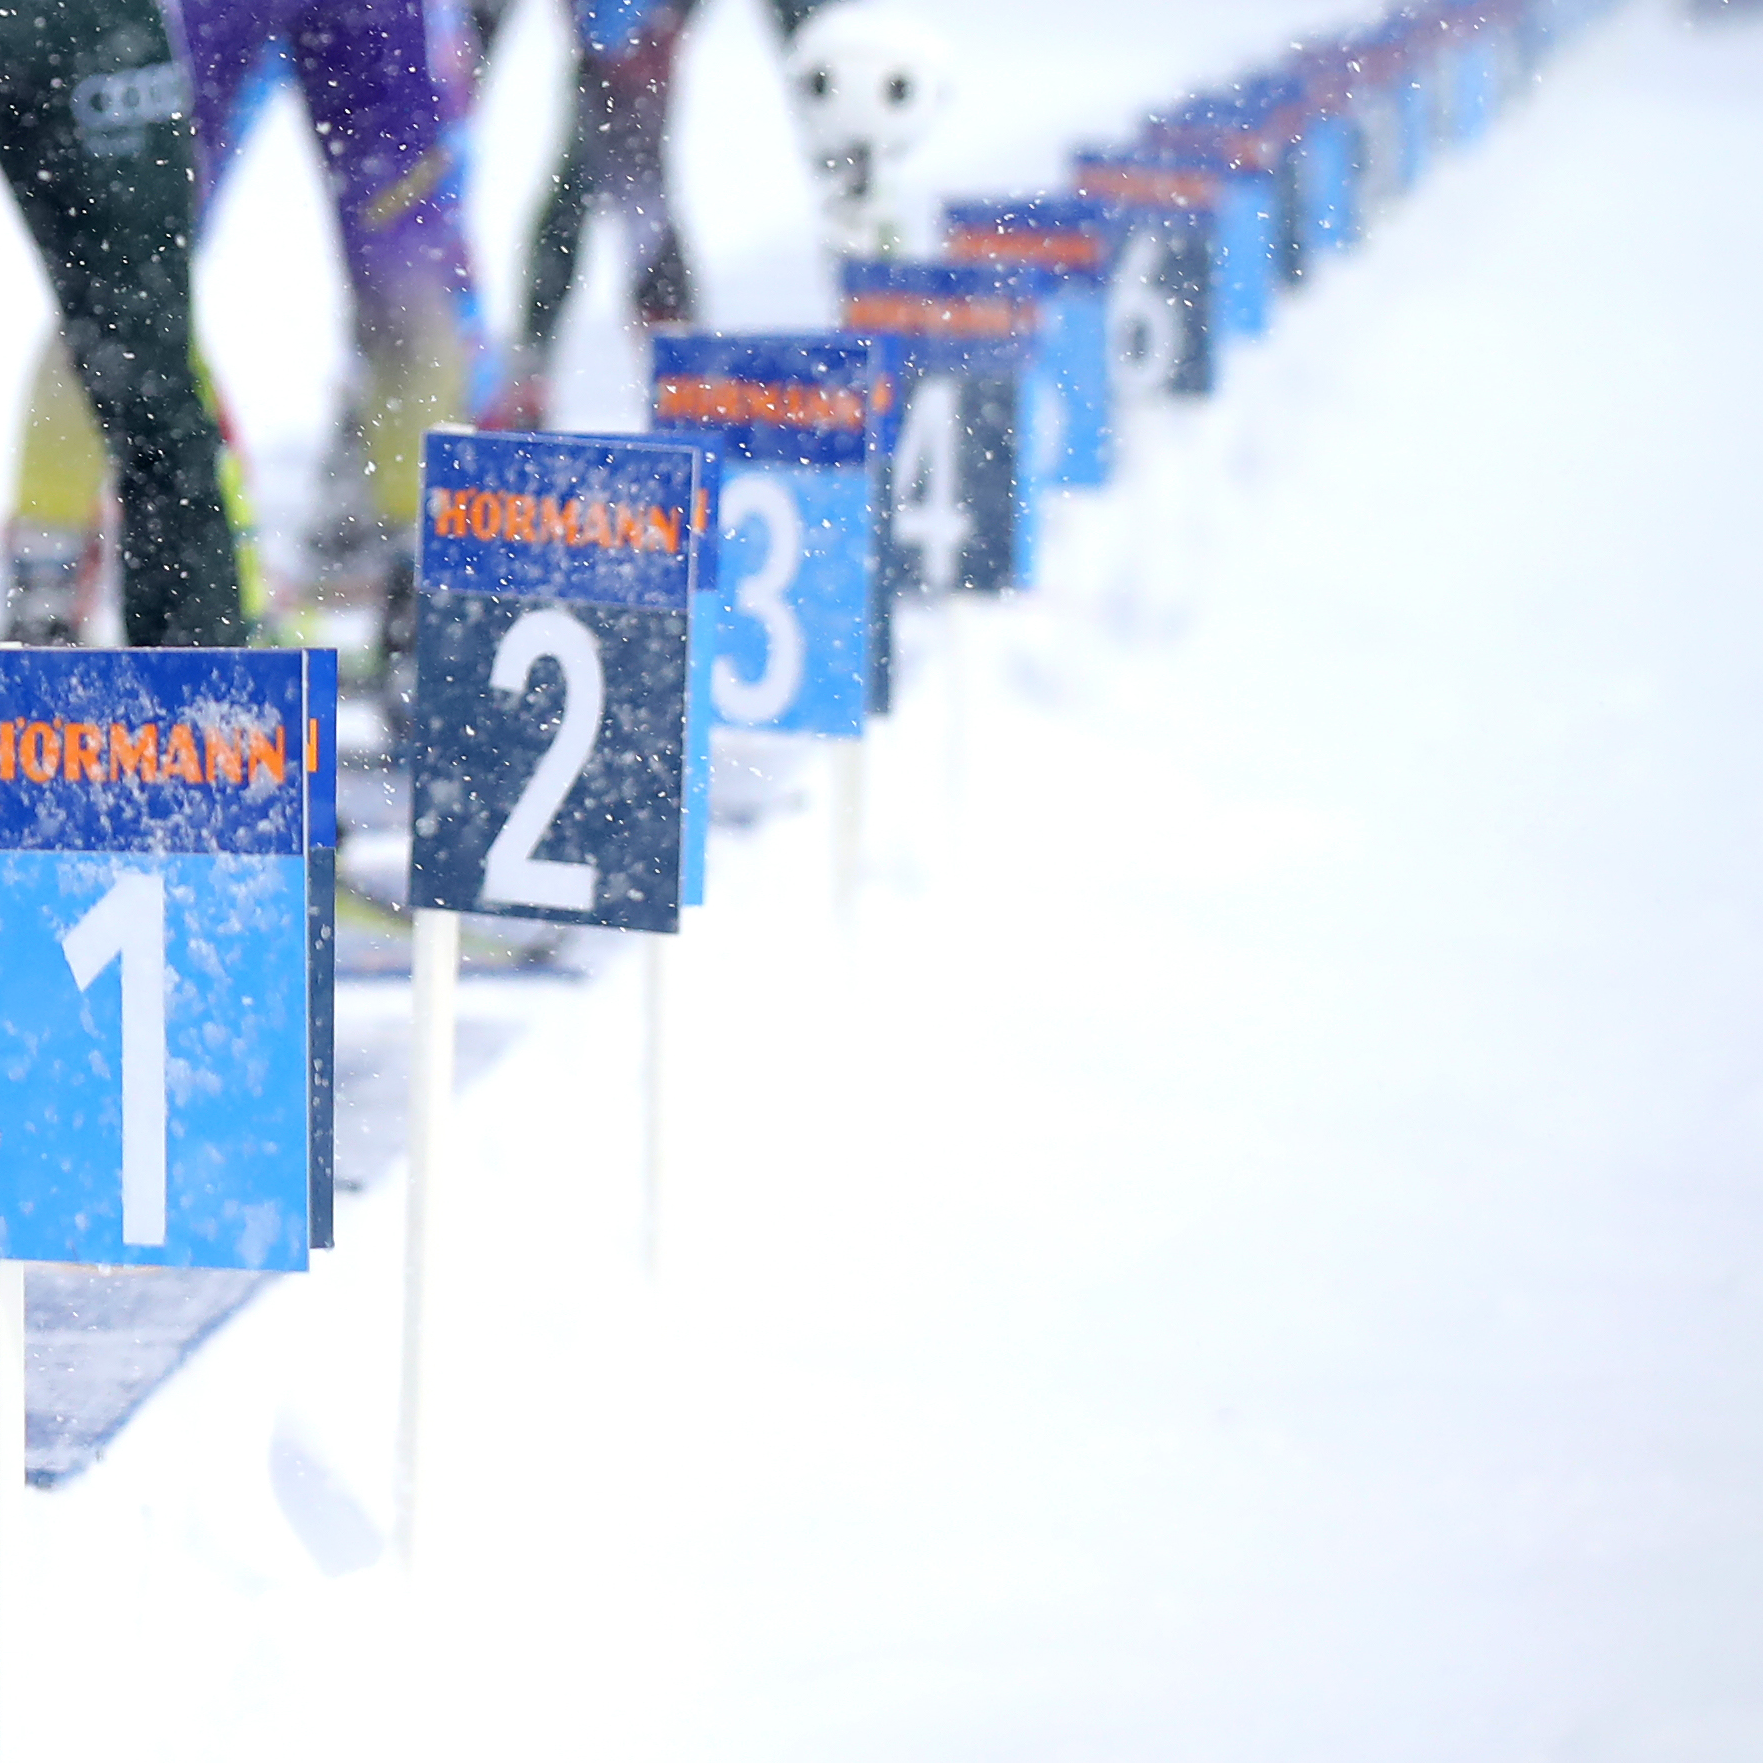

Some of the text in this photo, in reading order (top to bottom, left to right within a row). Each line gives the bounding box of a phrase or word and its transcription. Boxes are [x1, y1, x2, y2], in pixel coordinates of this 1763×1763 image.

[710, 469, 807, 725] 3
[891, 376, 979, 588] 4
[483, 606, 606, 912] 2
[60, 870, 168, 1248] 1
